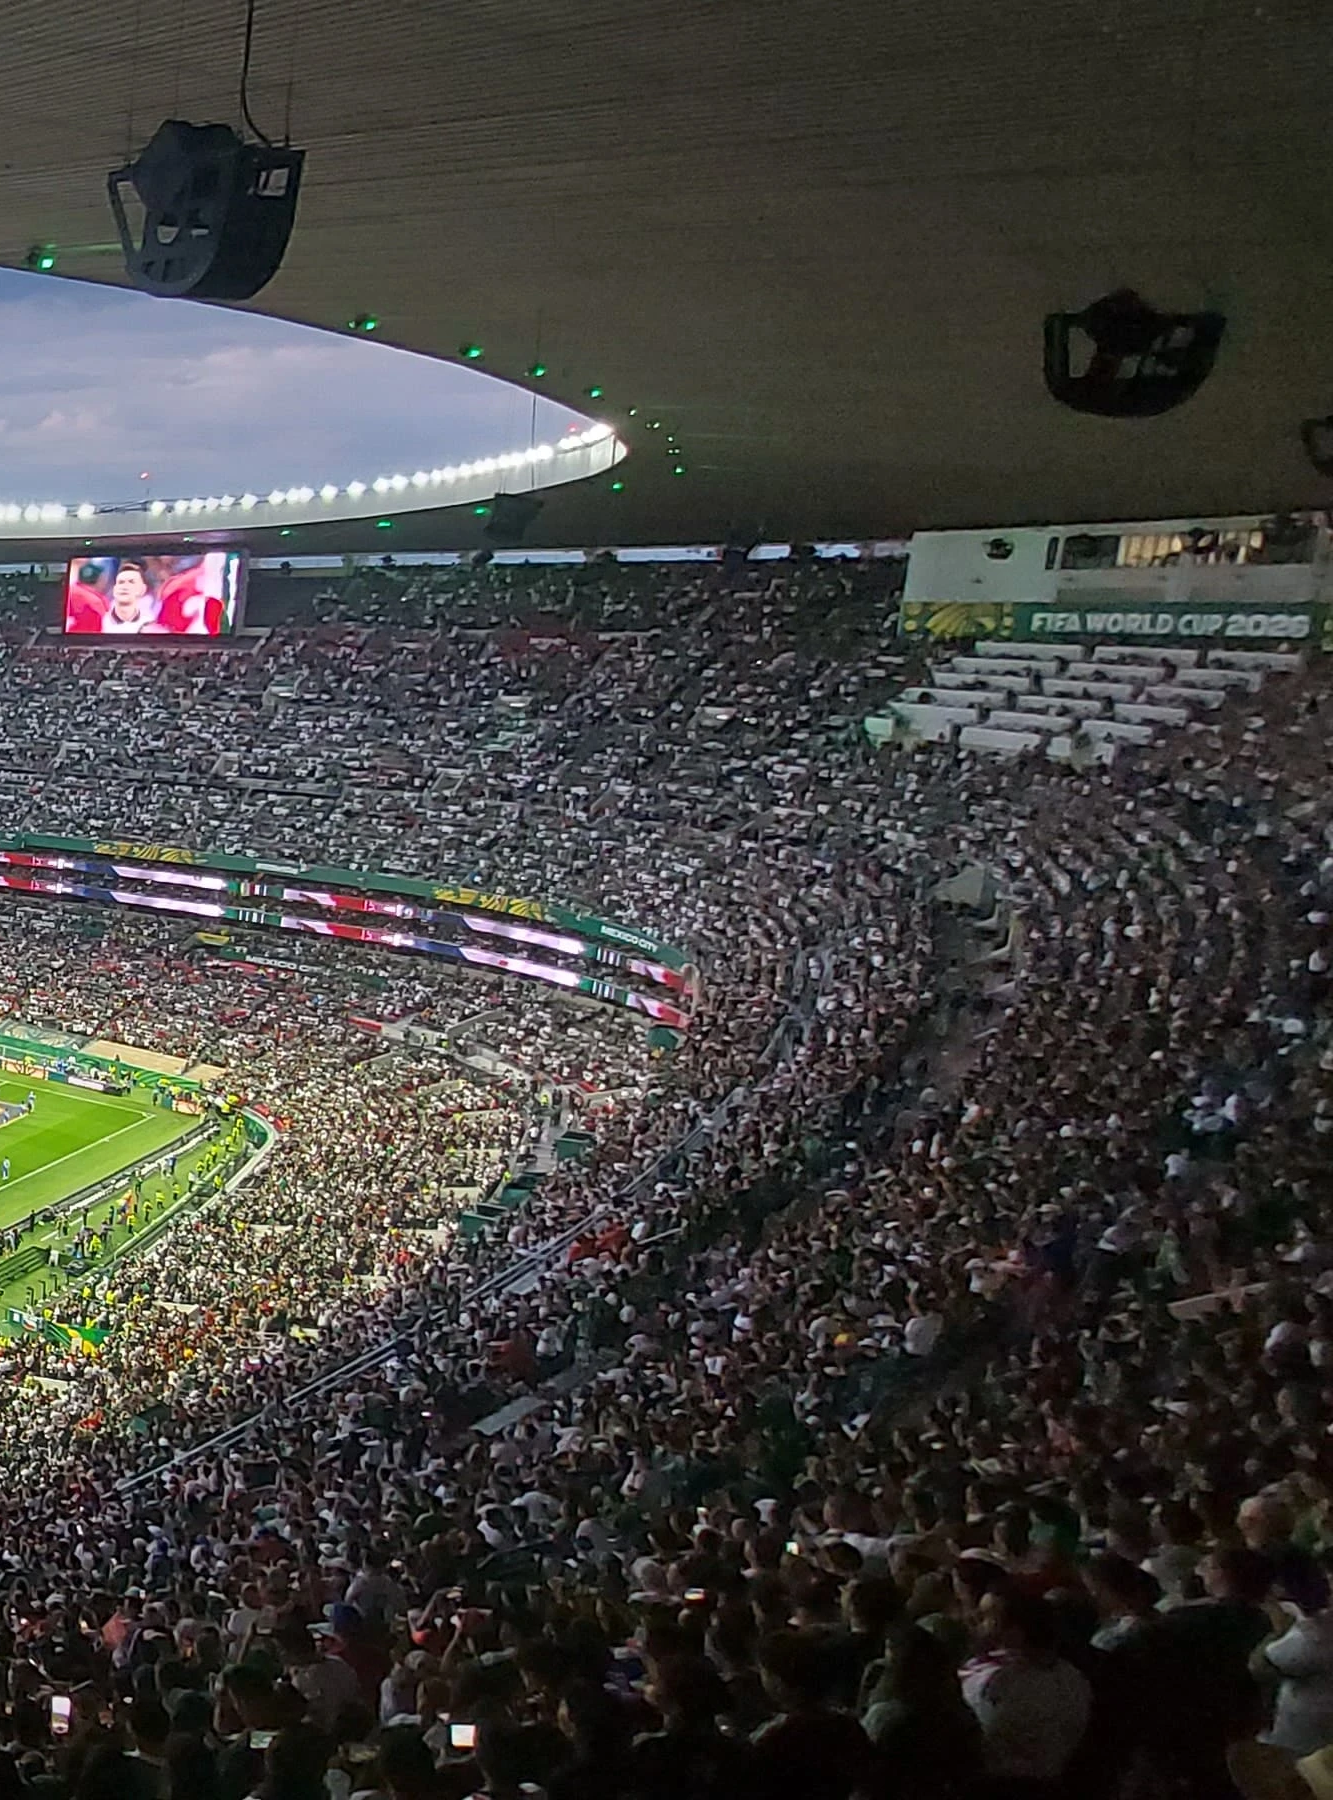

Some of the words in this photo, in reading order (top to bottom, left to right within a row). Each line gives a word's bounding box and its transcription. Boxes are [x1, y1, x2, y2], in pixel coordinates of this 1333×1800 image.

[1031, 612, 1081, 632] FIFA
[1086, 613, 1174, 635] WORLD
[1178, 613, 1223, 635] CUP
[1225, 614, 1310, 638] 2026
[244, 955, 297, 971] MEXICO
[299, 965, 331, 976] CIT
